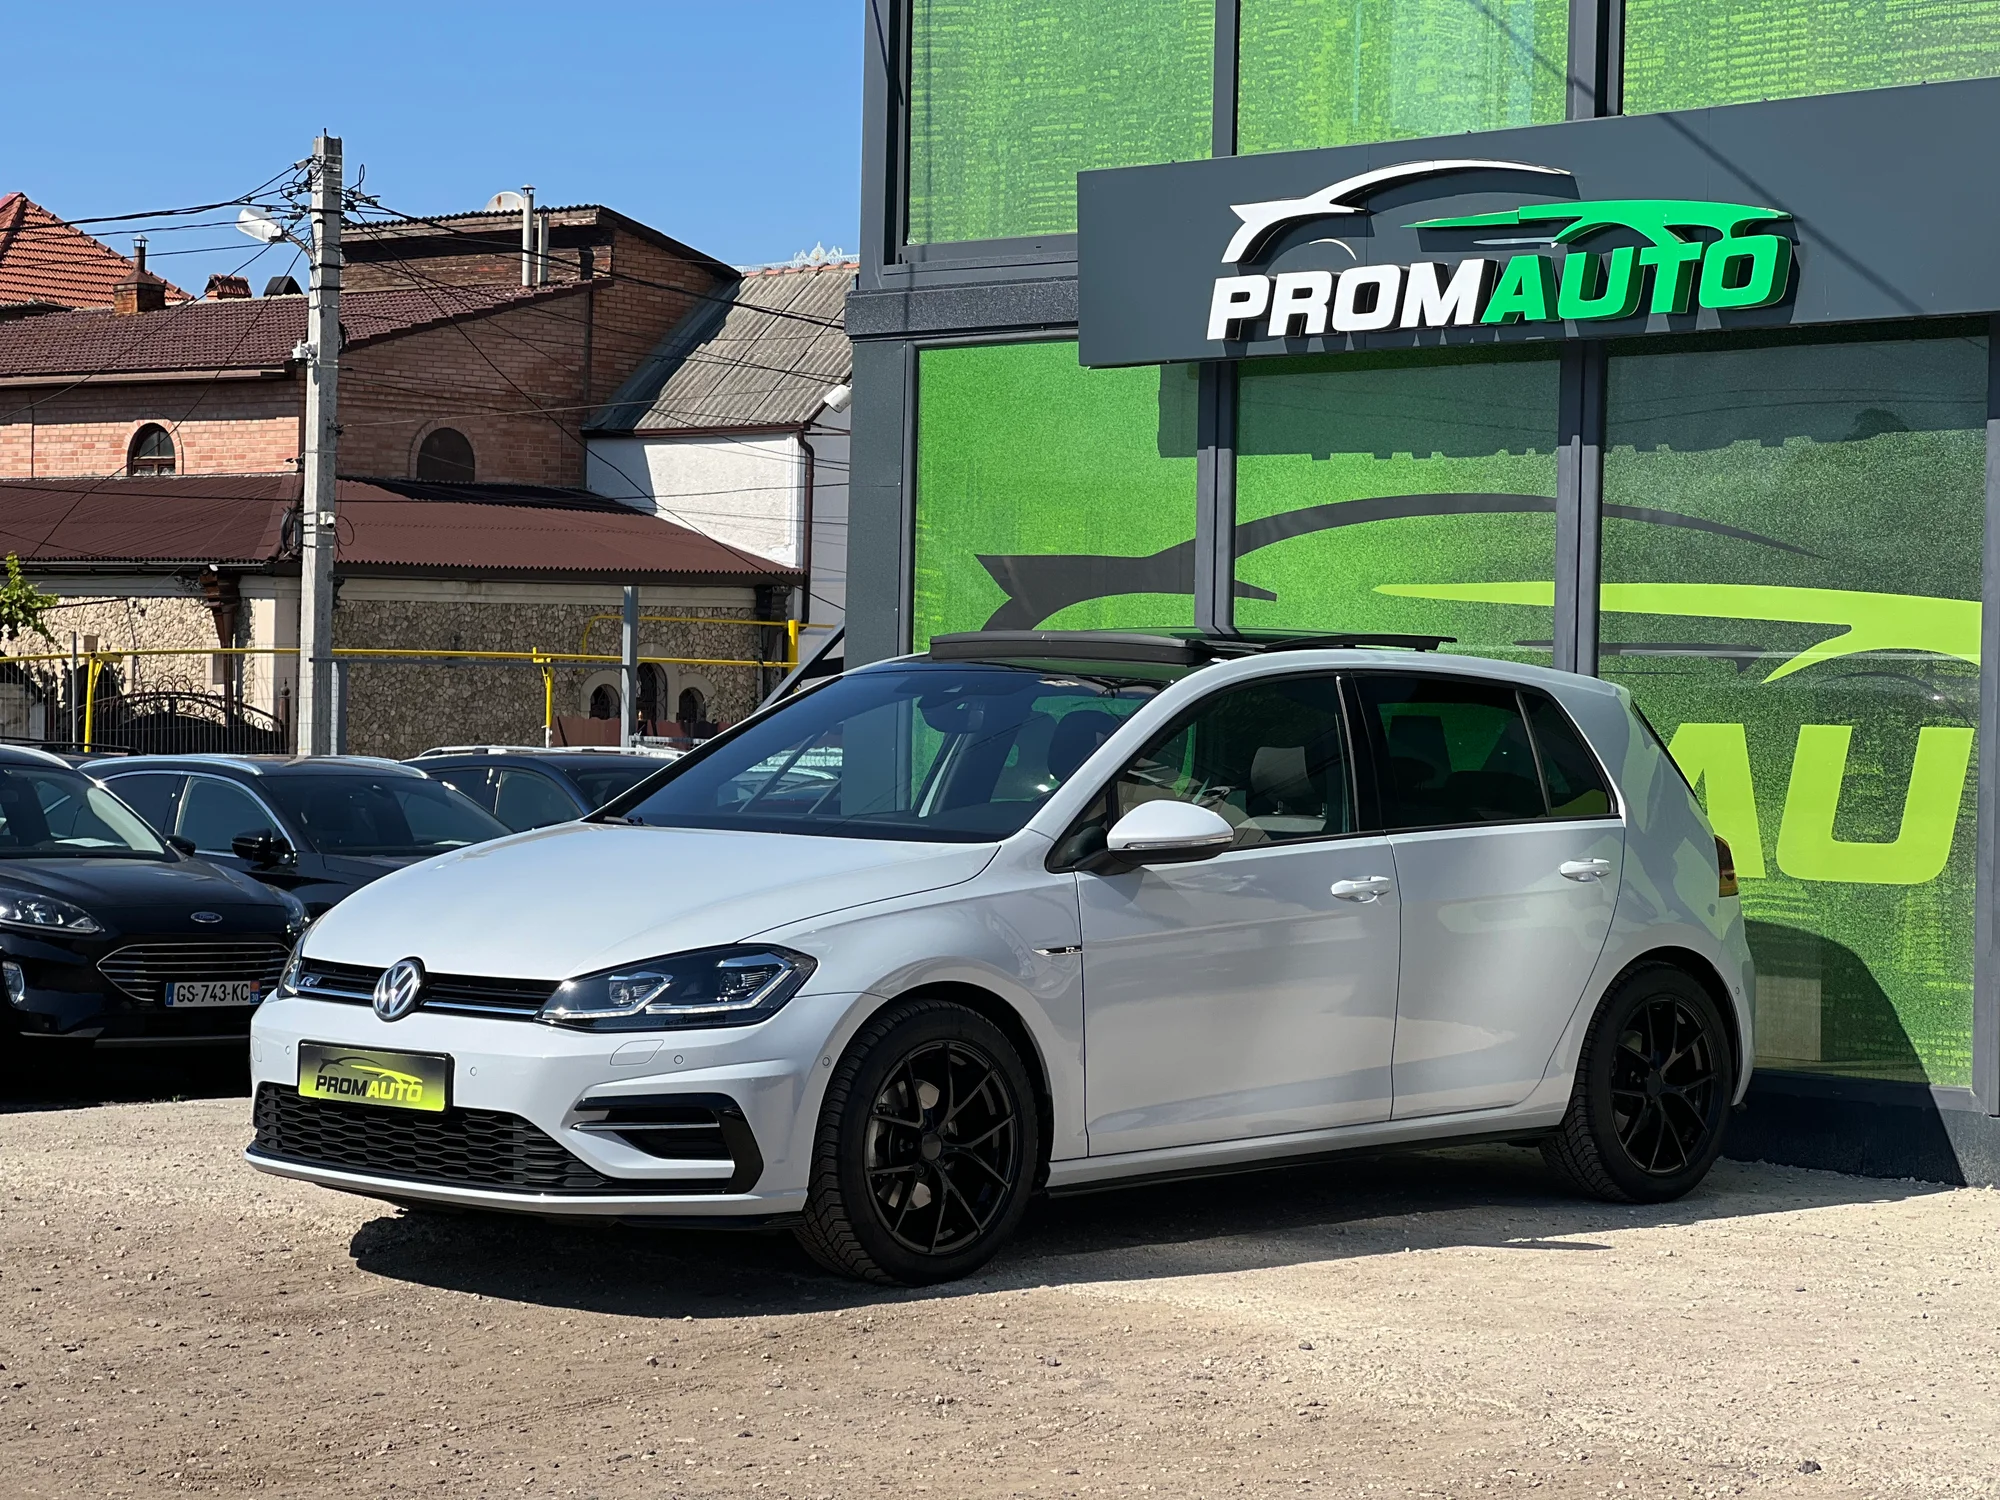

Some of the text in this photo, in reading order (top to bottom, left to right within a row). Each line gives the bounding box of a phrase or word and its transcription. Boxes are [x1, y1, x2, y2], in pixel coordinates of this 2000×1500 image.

[1206, 233, 1791, 340] PROMAUTO
[177, 984, 249, 1002] GS-743-KC
[315, 1075, 423, 1102] PROMAUTO
